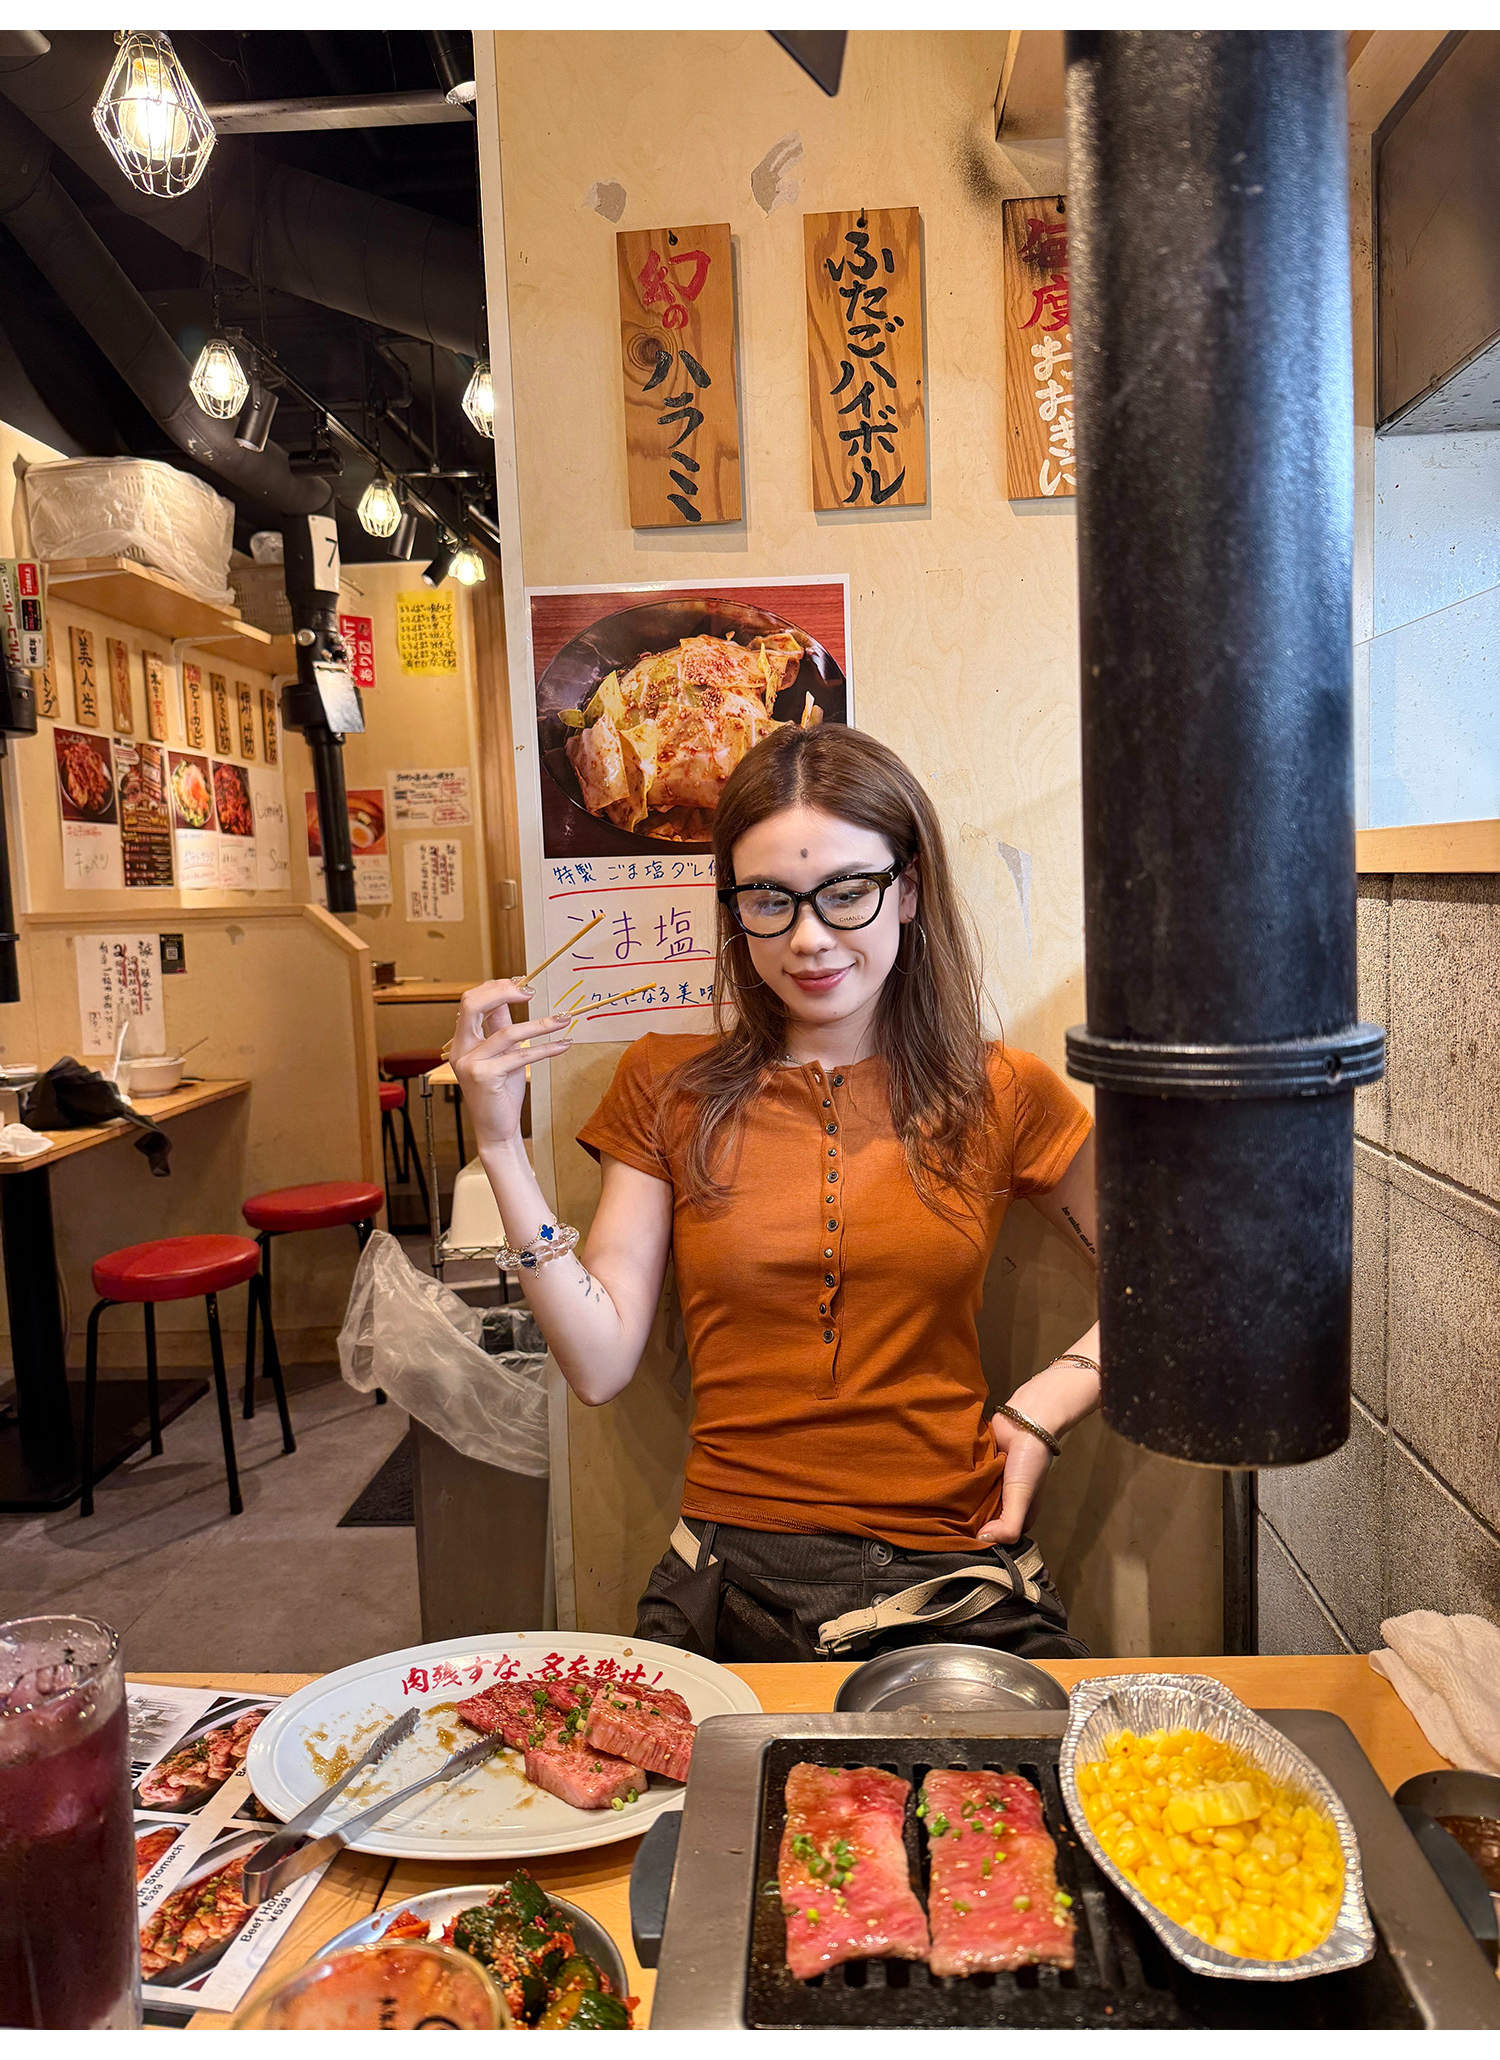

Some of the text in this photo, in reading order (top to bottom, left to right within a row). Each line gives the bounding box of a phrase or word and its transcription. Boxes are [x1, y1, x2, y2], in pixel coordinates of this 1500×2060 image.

[824, 230, 907, 505] ふたごハイボール
[636, 249, 713, 523] 幻のハラミ
[324, 536, 338, 568] 7
[144, 1844, 185, 1885] Stomach
[137, 1883, 164, 1908] ¥539
[267, 1896, 292, 1923] ¥539
[240, 1917, 264, 1942] Beef
